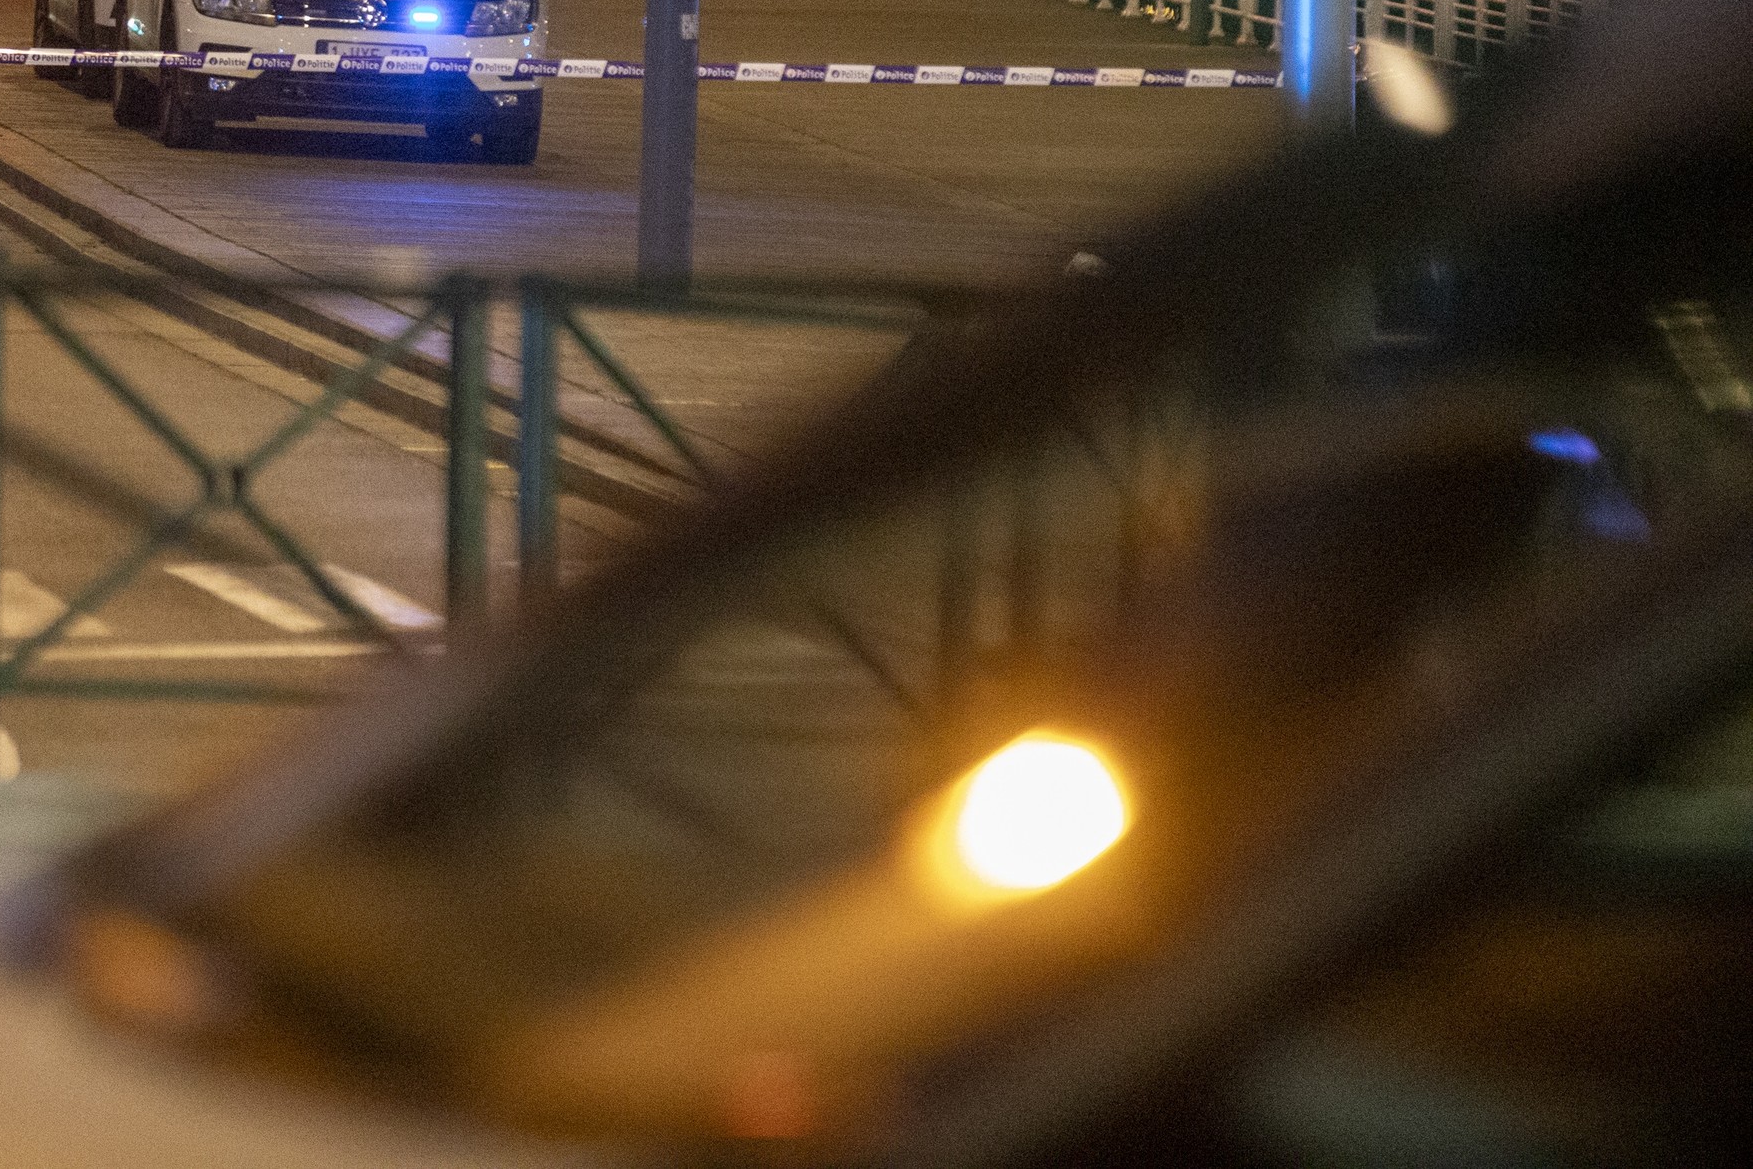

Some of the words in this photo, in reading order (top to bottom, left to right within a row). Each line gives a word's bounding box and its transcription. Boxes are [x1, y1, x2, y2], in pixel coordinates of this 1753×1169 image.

[41, 54, 69, 63] Politie
[217, 57, 245, 66] Politie
[263, 58, 292, 68] Police
[306, 59, 335, 69] Politie
[351, 61, 380, 70] Police
[396, 62, 424, 71] Politie
[440, 63, 468, 72] Police
[484, 63, 512, 73] Politie
[528, 64, 557, 74] Police
[572, 65, 601, 74] Politie
[706, 68, 735, 78] Police
[752, 68, 781, 78] Politie
[796, 69, 825, 79] Police
[841, 70, 869, 80] Politie
[885, 71, 914, 81] Police
[931, 72, 959, 81] Politie
[975, 72, 1004, 82] Police
[1020, 73, 1048, 82] Politie
[1065, 73, 1094, 83] Police
[1245, 74, 1275, 84] Police
